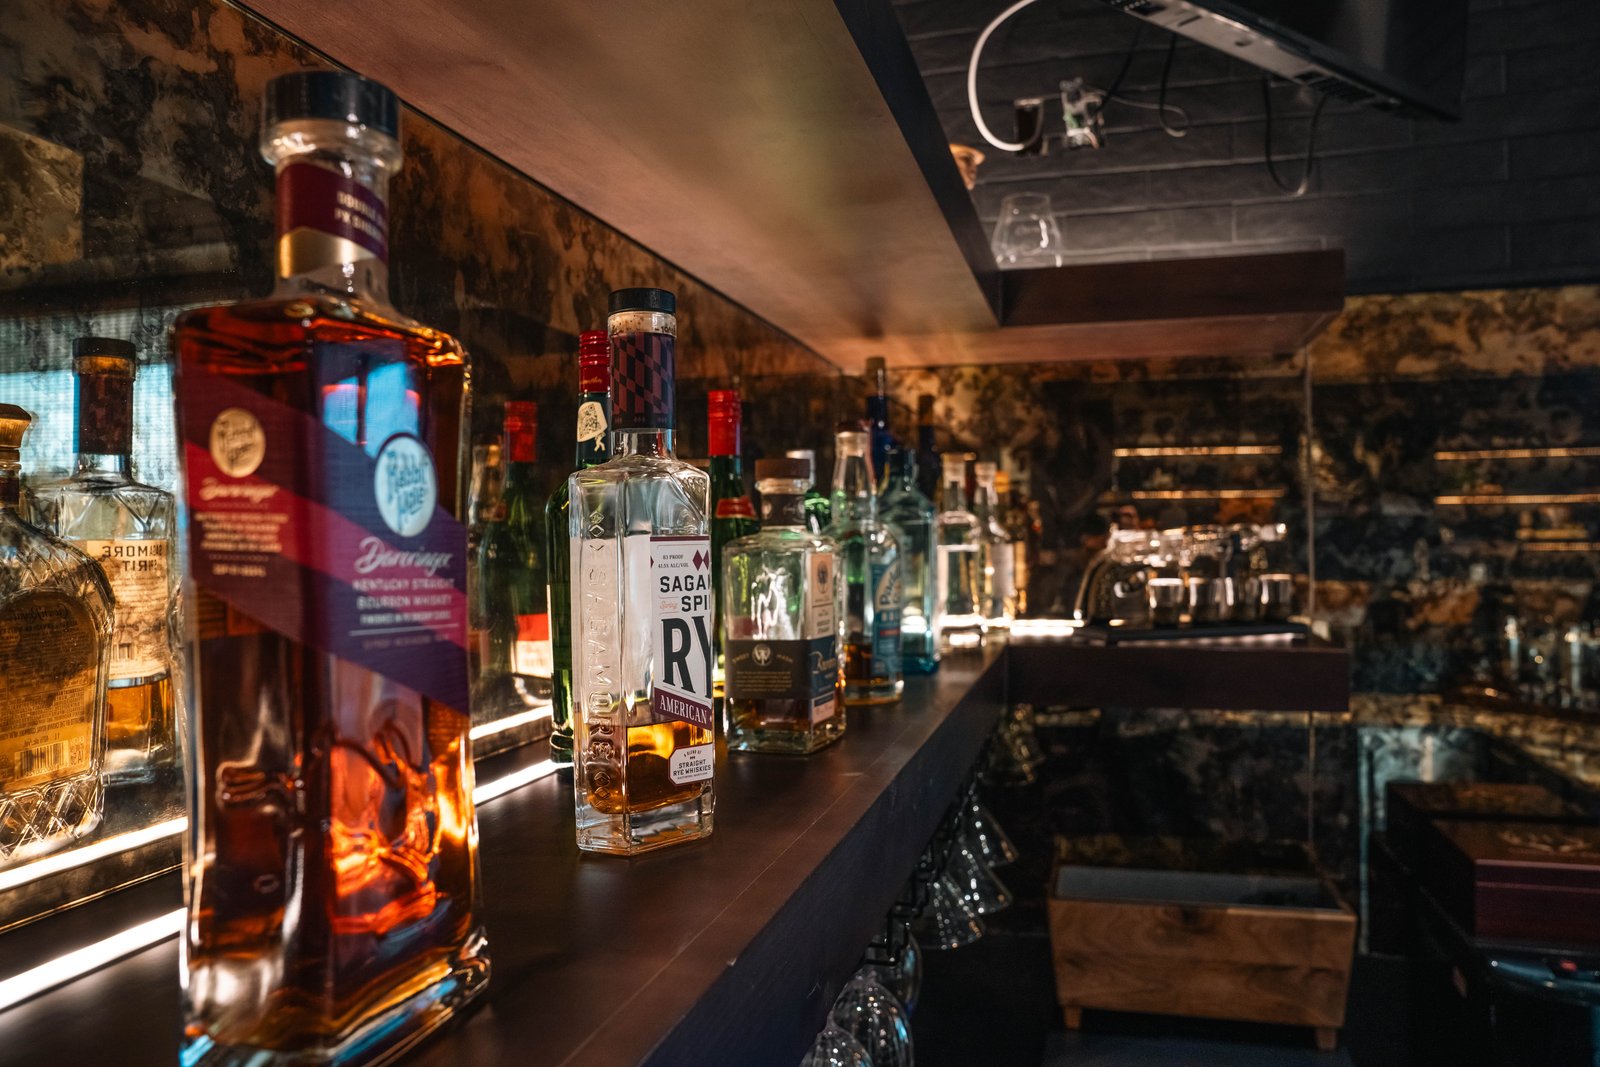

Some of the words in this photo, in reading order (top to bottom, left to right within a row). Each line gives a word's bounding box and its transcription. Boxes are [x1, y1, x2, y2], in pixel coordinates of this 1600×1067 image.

[681, 594, 711, 613] SPI
[660, 694, 707, 724] AMERICAN
[673, 769, 685, 777] RYE
[685, 764, 711, 775] WHISKIES
[678, 758, 706, 769] STRAIGHT
